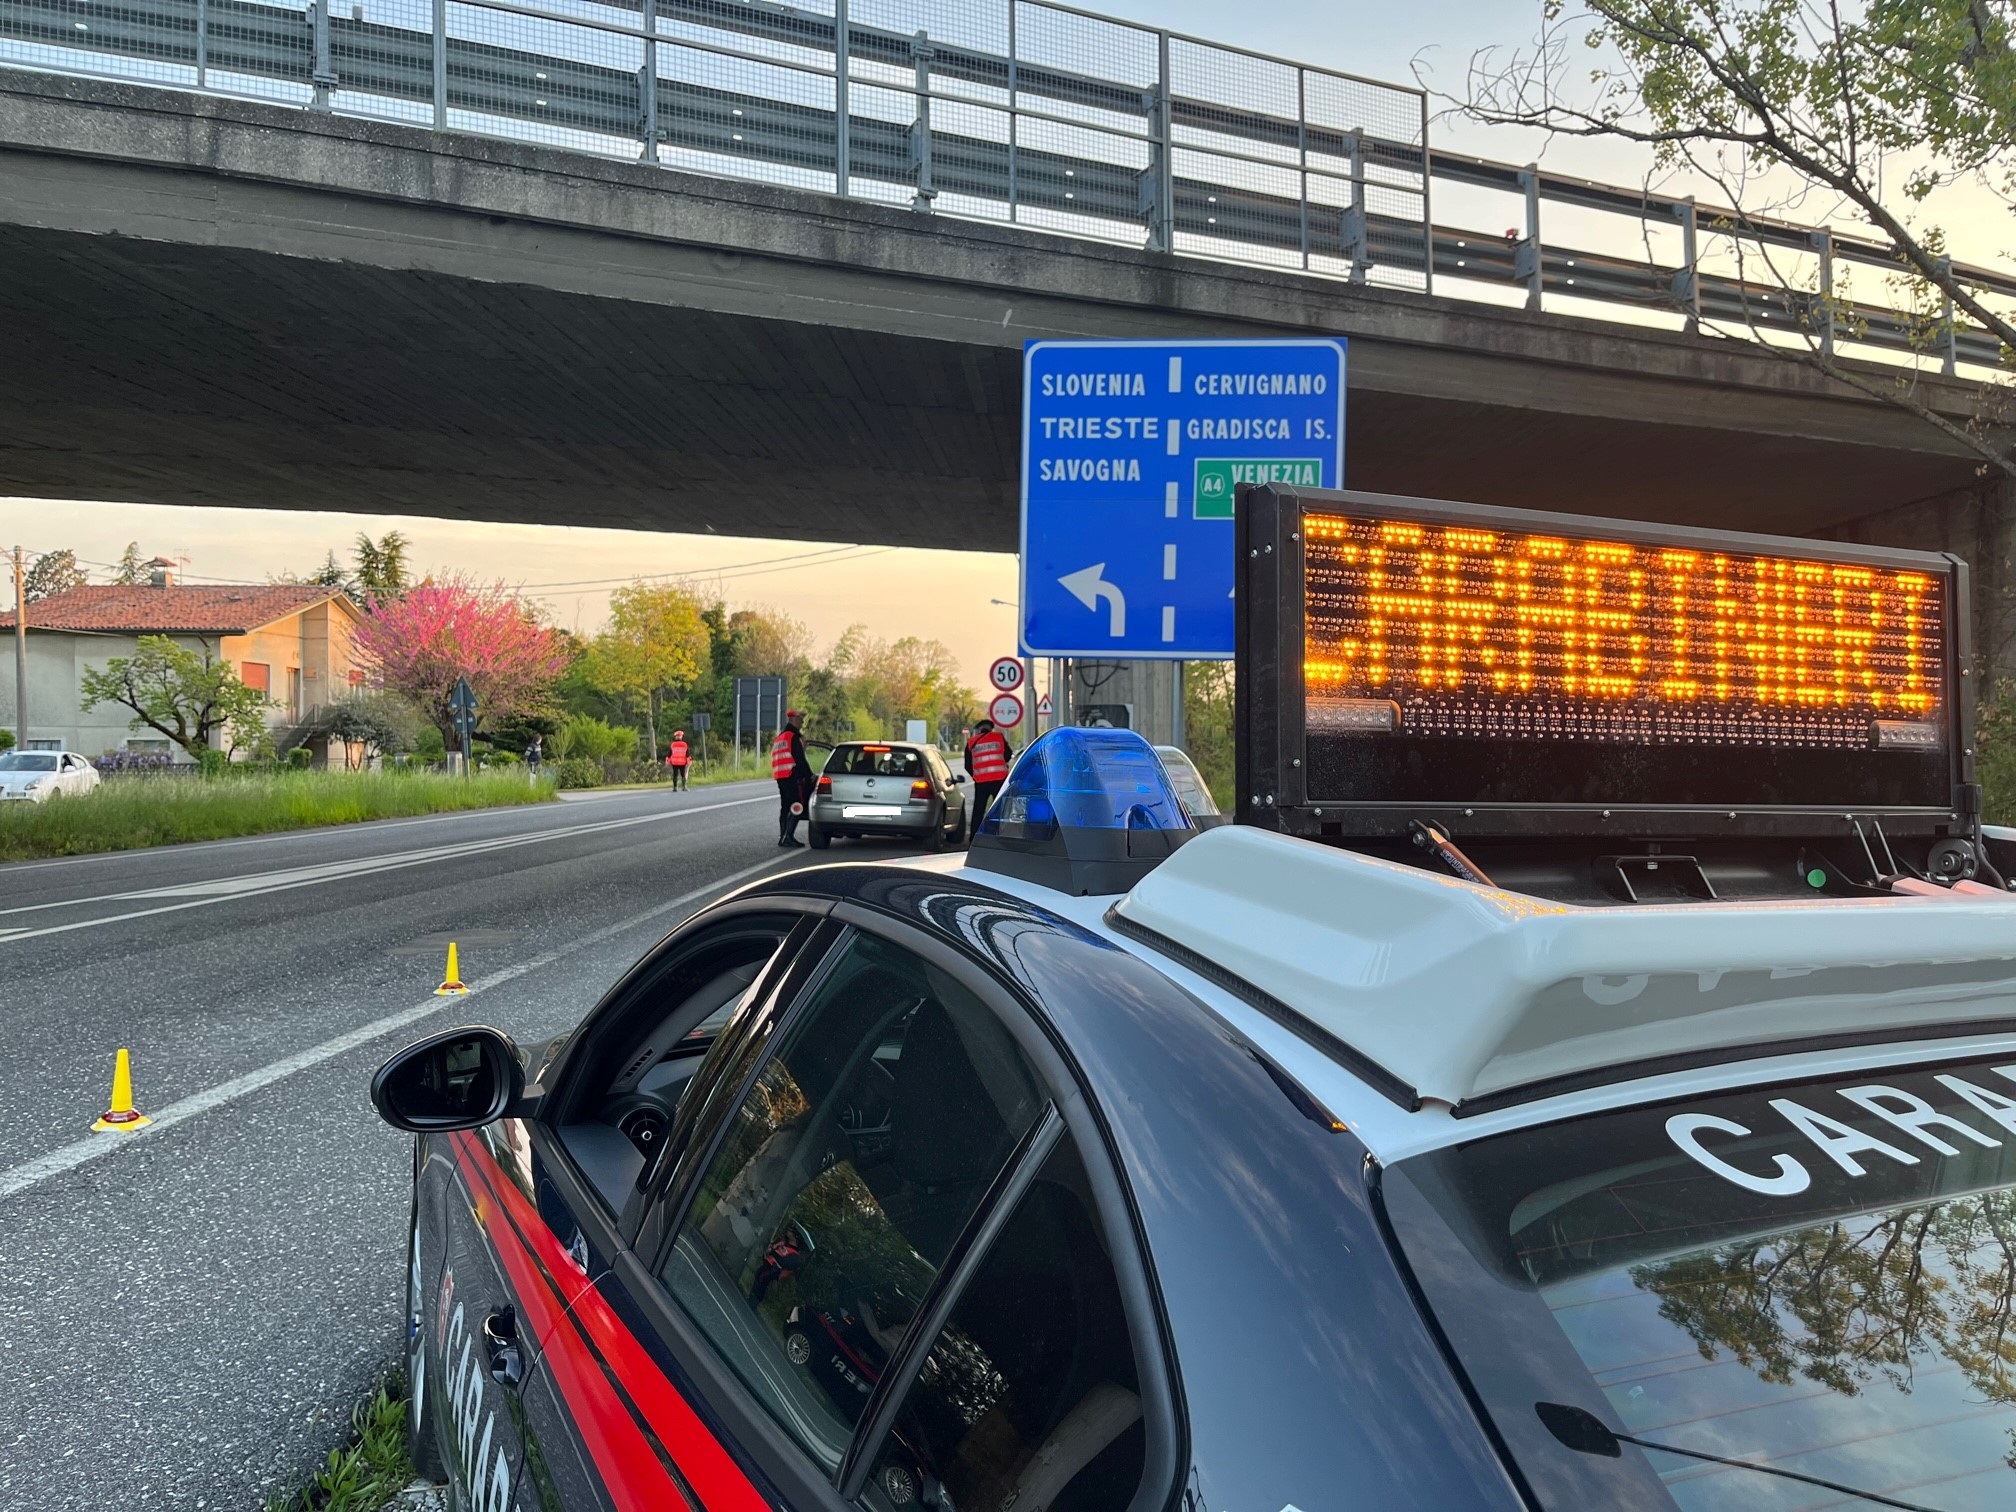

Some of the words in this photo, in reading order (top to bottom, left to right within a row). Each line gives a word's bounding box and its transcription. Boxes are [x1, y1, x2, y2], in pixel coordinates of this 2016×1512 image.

[1041, 373, 1146, 397] SLOVENIA
[1194, 374, 1327, 396] CERVIGNANO
[1039, 417, 1159, 439] TRIESTE
[1187, 418, 1290, 440] GRADISCA
[1305, 418, 1331, 441] IS.
[1039, 458, 1141, 482] SAVOGNA
[1231, 464, 1315, 485] VENEZIA
[1203, 477, 1222, 493] A4
[997, 666, 1017, 683] 50
